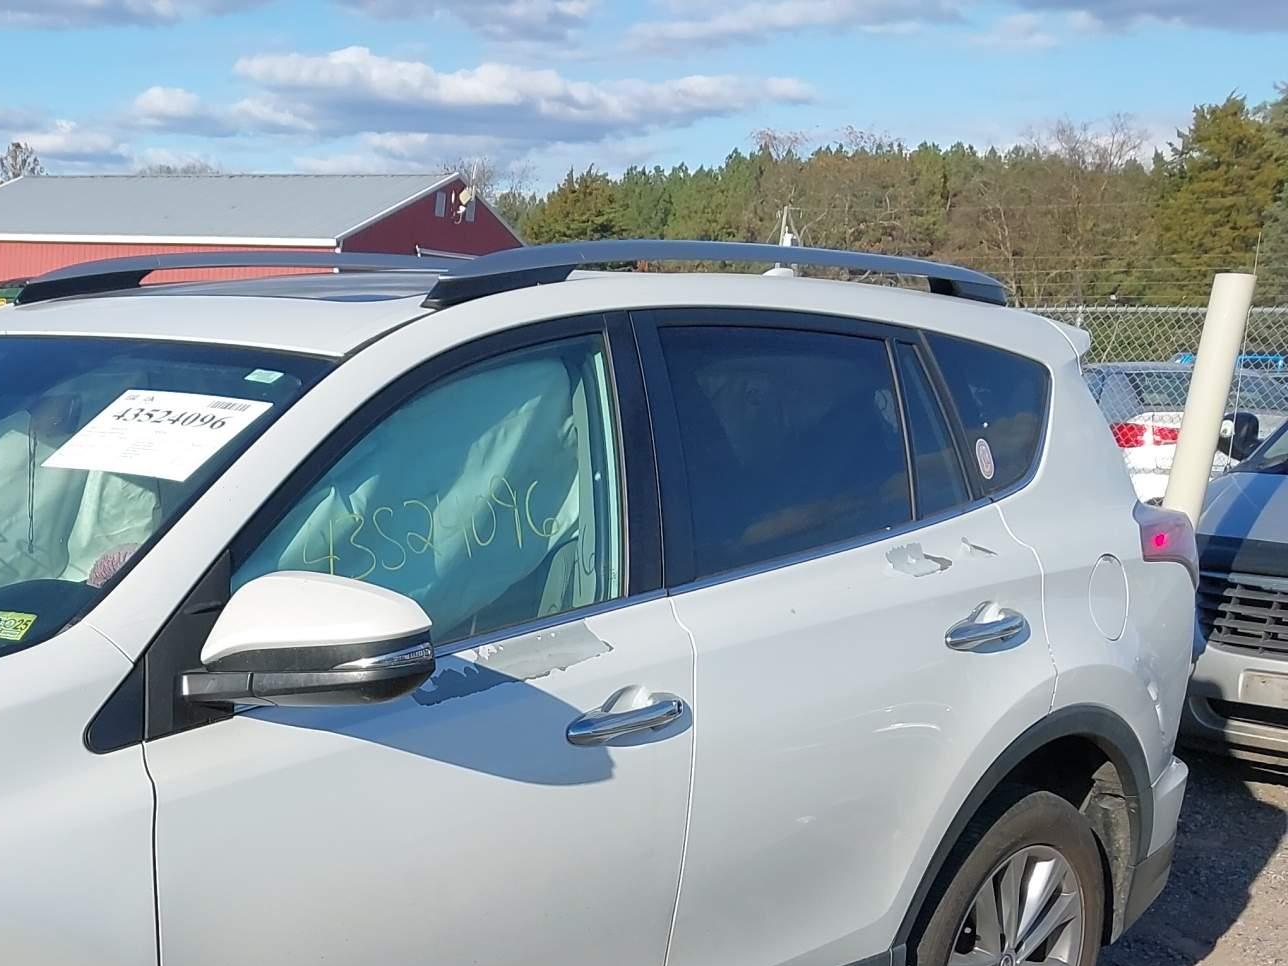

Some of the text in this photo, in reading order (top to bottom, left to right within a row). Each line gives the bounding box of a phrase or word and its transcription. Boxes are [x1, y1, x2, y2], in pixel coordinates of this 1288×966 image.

[113, 407, 232, 429] 43524096
[303, 474, 560, 580] 43524096
[14, 618, 32, 631] 25
